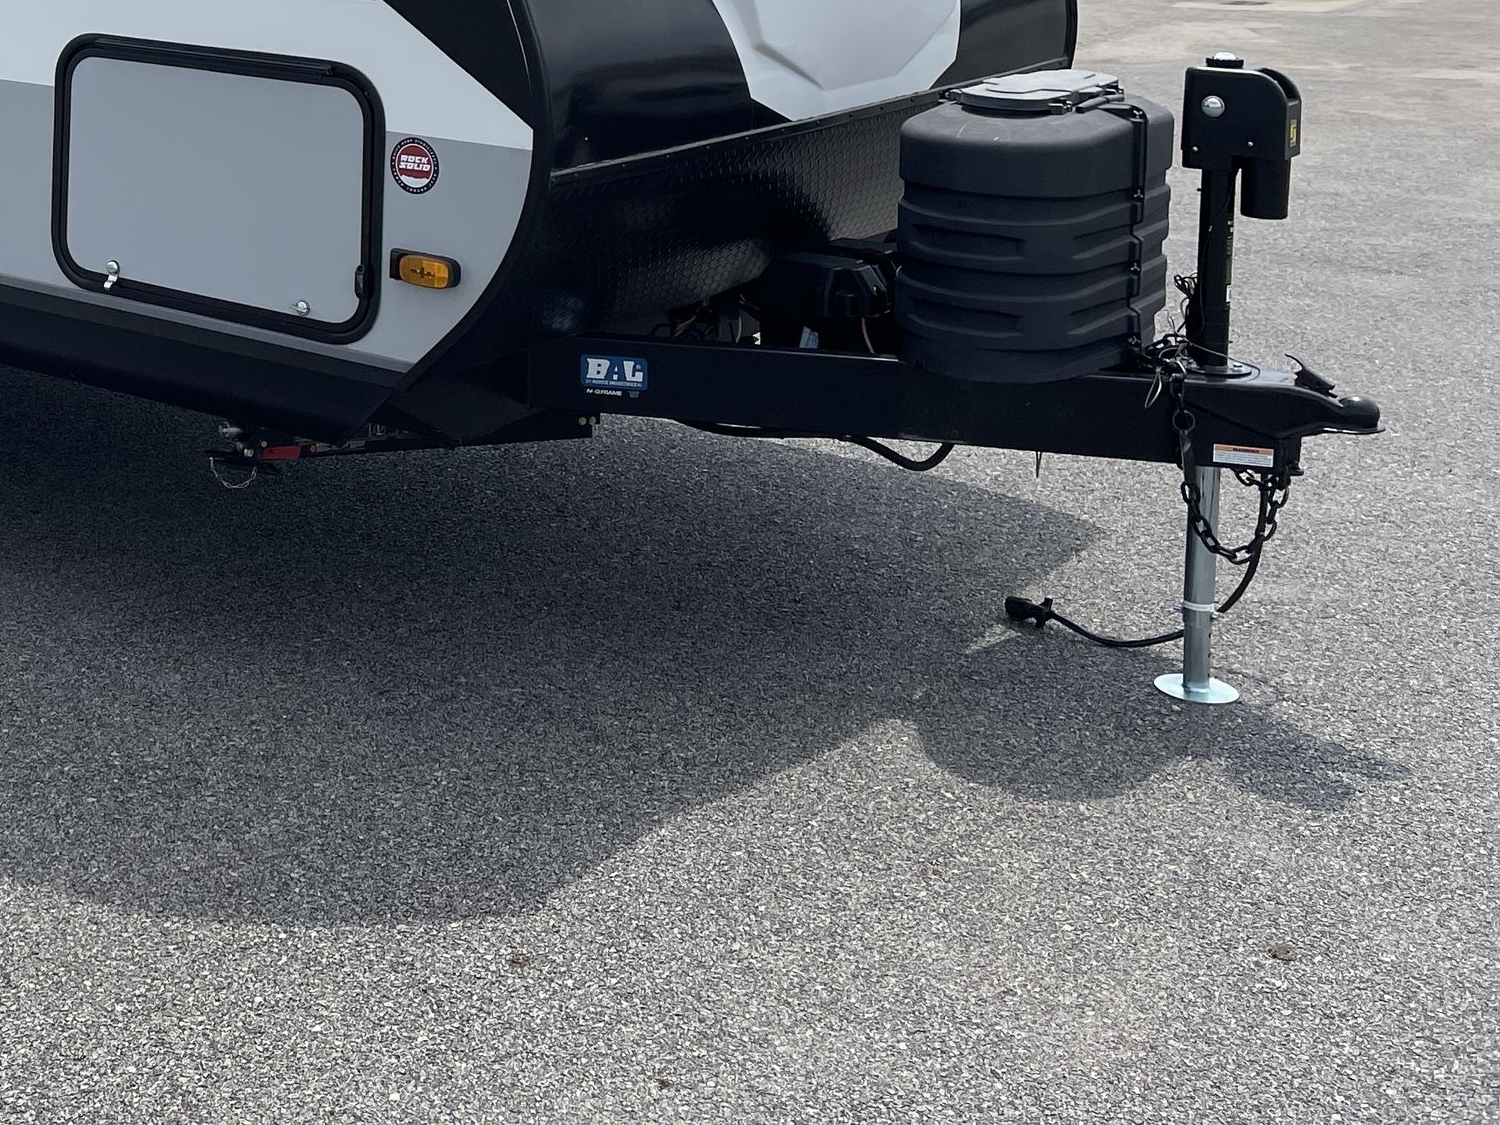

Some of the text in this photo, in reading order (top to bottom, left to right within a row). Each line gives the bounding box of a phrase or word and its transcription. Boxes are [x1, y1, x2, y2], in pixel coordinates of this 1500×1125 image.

[400, 154, 429, 164] ROCK
[398, 161, 431, 172] SOLID
[586, 357, 644, 381] BAL
